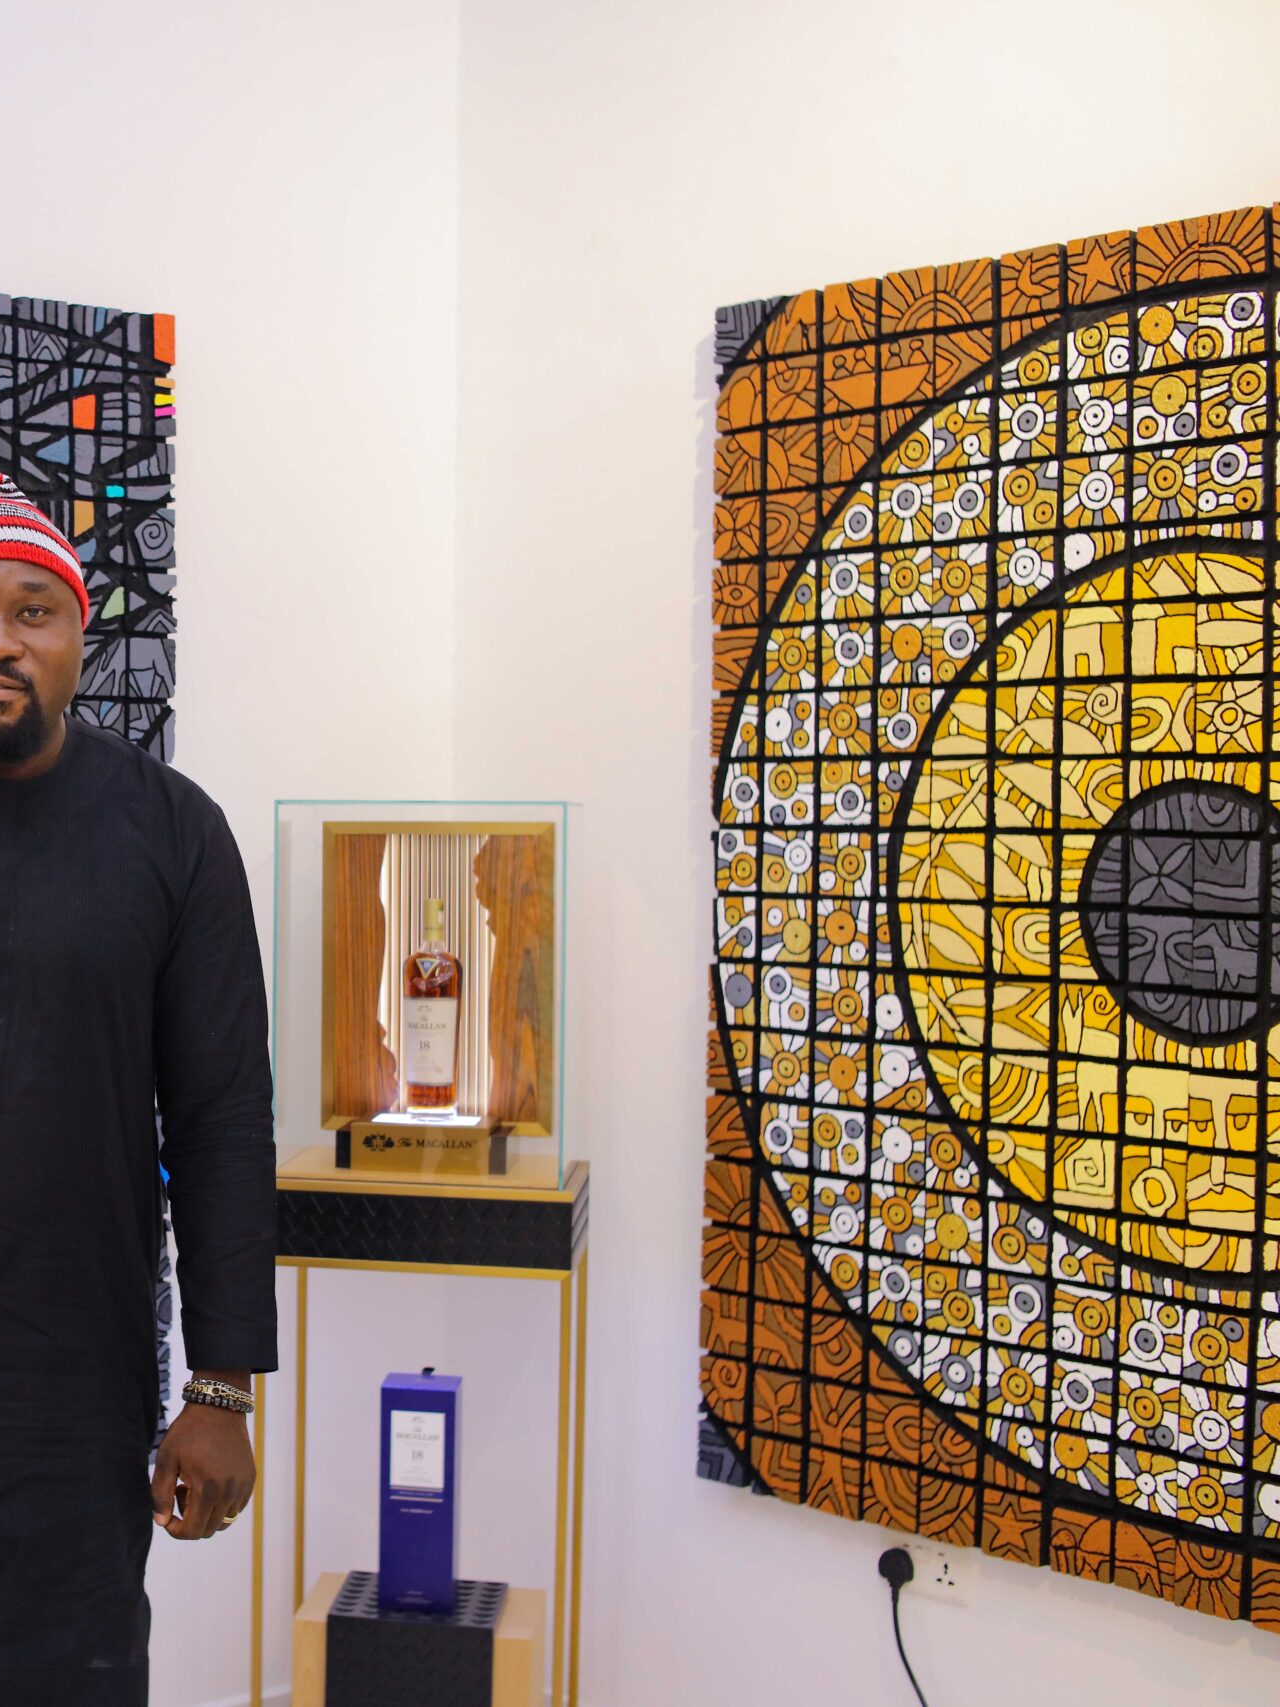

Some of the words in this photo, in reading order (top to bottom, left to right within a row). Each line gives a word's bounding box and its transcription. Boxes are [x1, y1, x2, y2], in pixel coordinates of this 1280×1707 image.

[419, 1040, 430, 1050] 18
[416, 1138, 474, 1150] MACALLAN
[411, 1449, 424, 1460] 18
